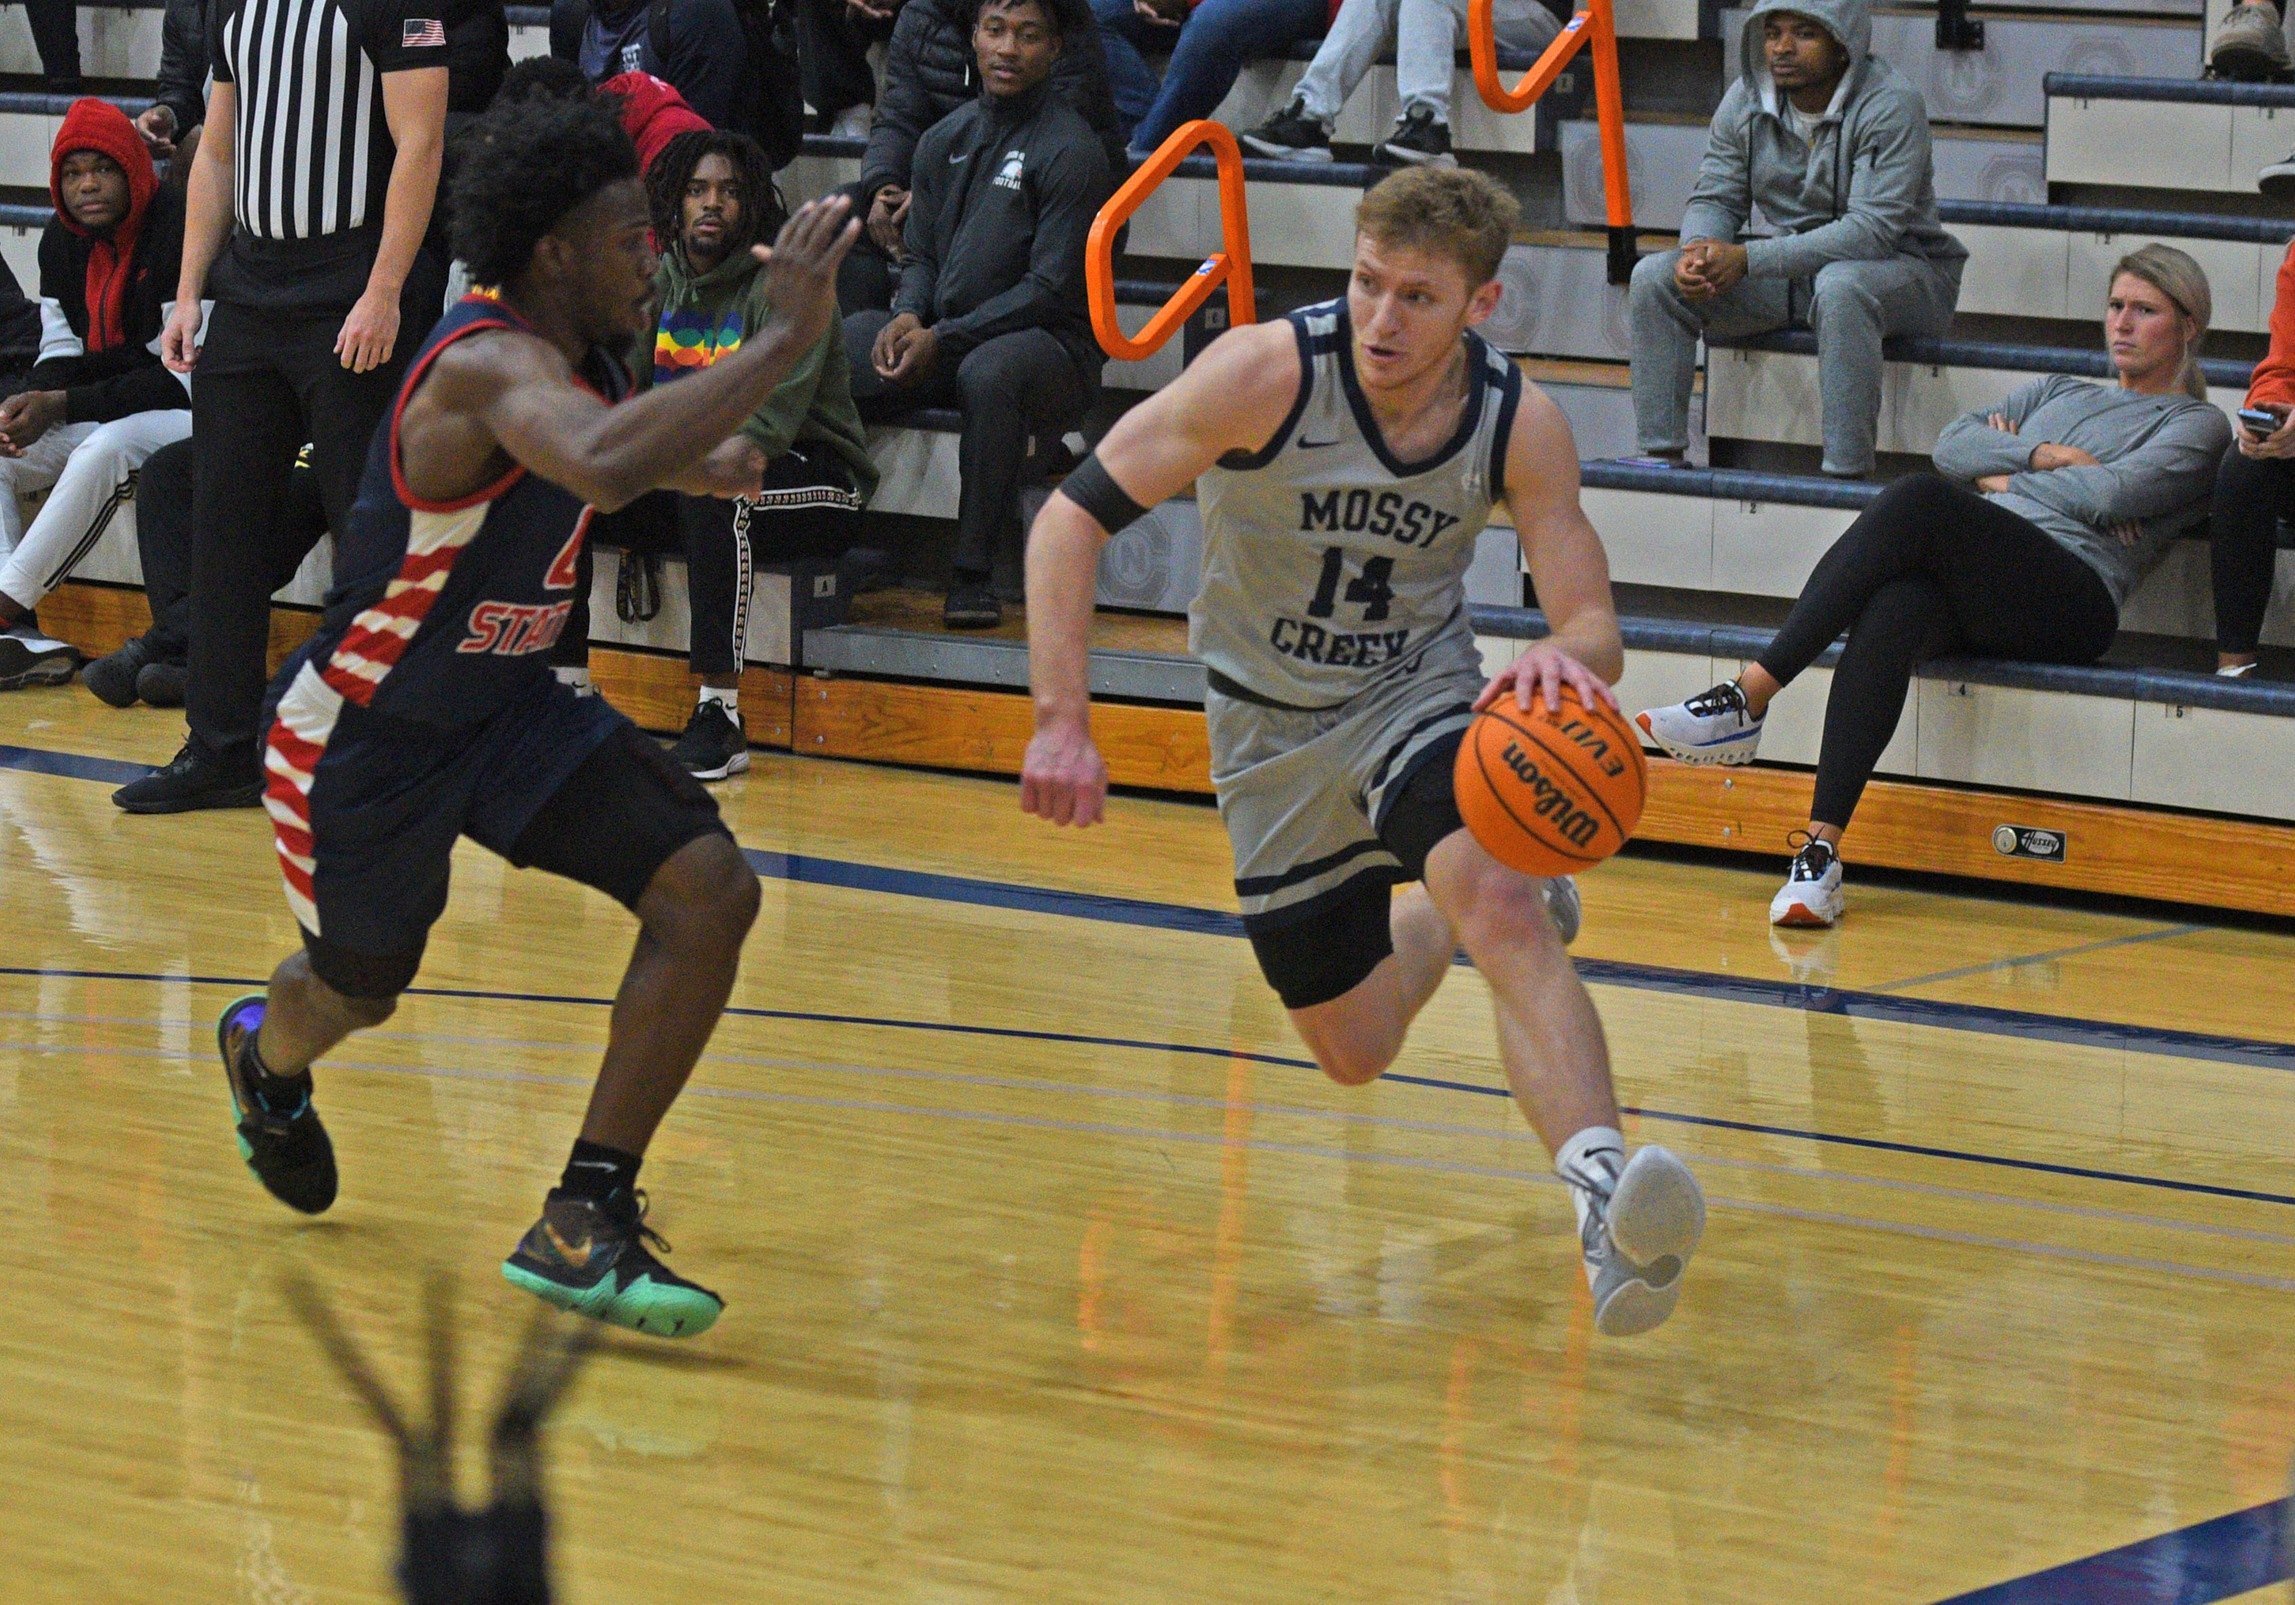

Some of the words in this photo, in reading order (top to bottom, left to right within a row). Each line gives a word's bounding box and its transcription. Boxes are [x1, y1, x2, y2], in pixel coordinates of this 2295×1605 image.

[1301, 489, 1460, 548] MOSSY
[1749, 502, 1757, 514] 2
[1307, 546, 1396, 622] 14
[2175, 704, 2184, 718] 5
[1501, 738, 1600, 848] Wilson
